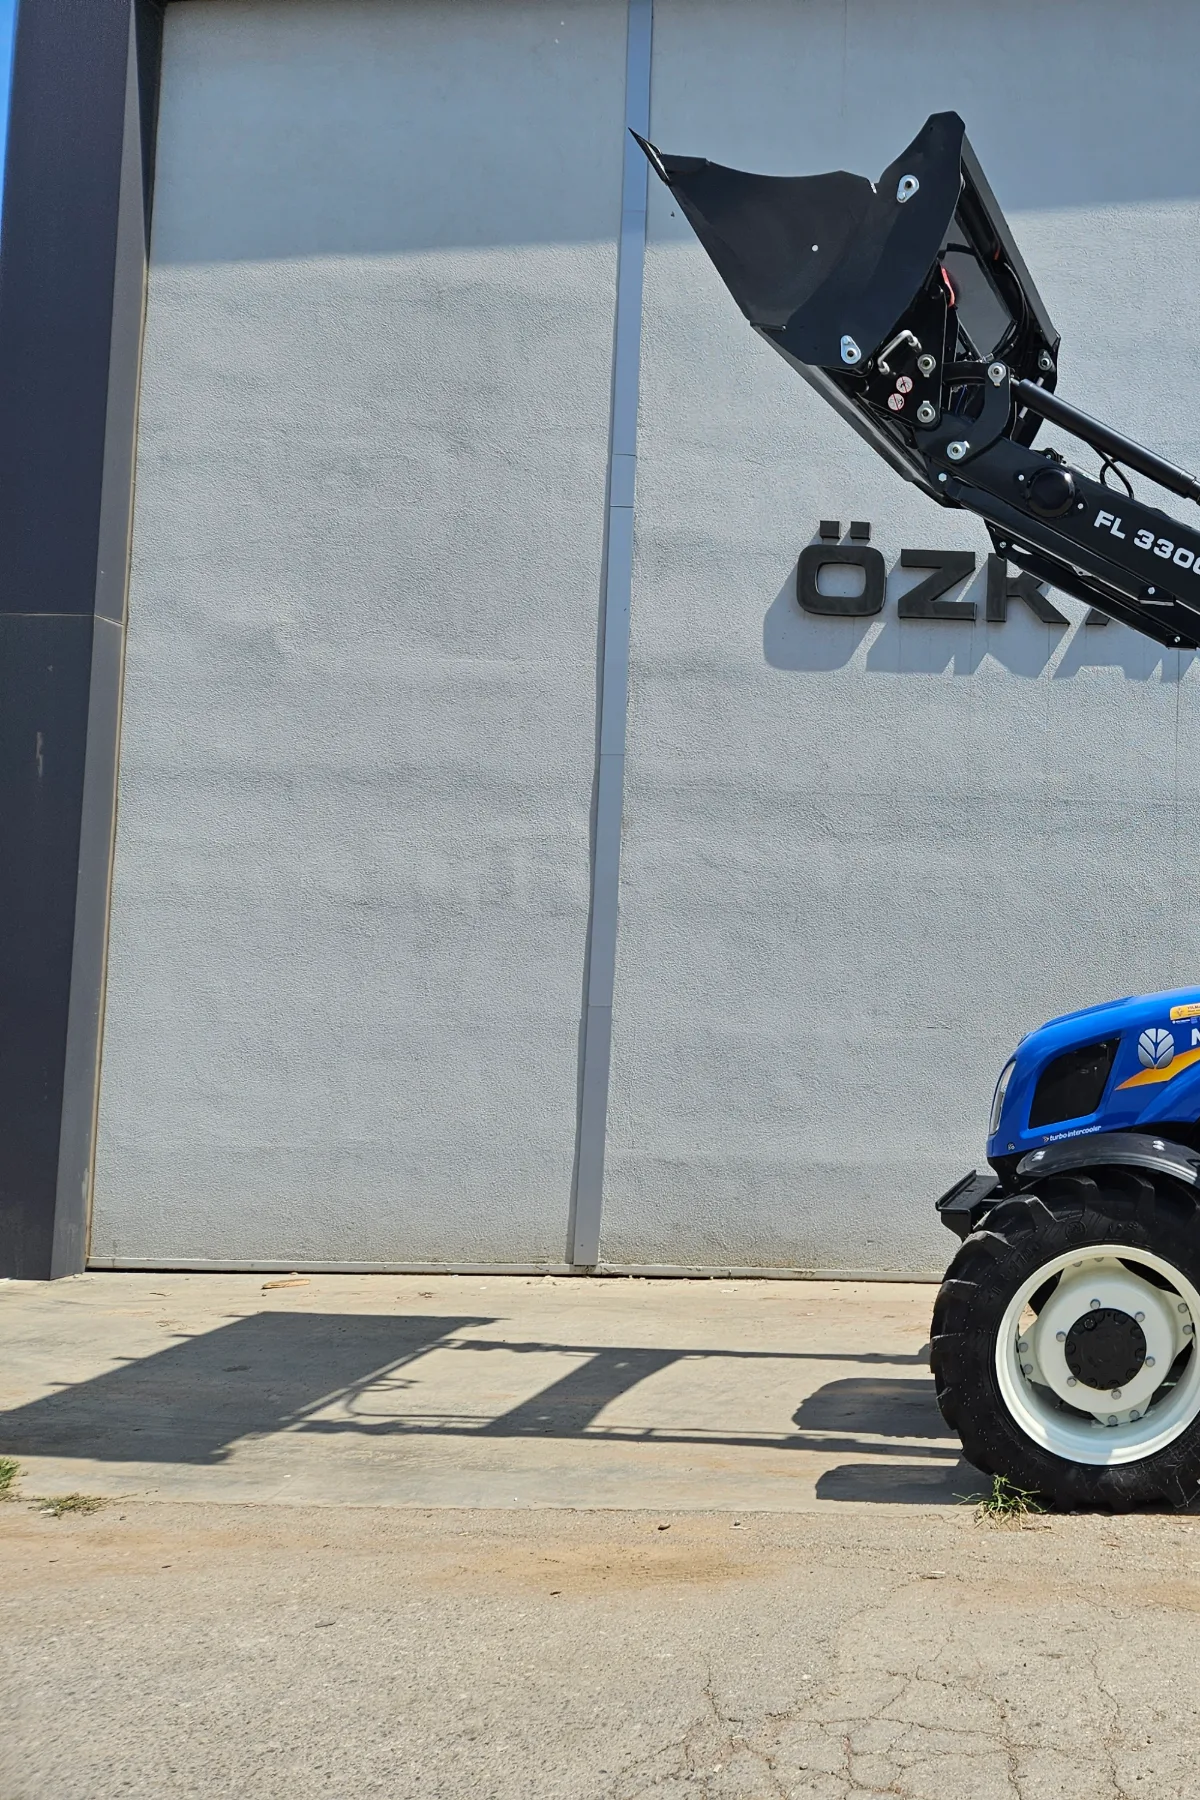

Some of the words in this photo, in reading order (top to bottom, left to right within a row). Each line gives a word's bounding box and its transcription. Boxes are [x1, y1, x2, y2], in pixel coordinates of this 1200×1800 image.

[1093, 510, 1126, 540] FL
[1049, 1133, 1067, 1142] turbo
[1067, 1125, 1102, 1138] intercooler
